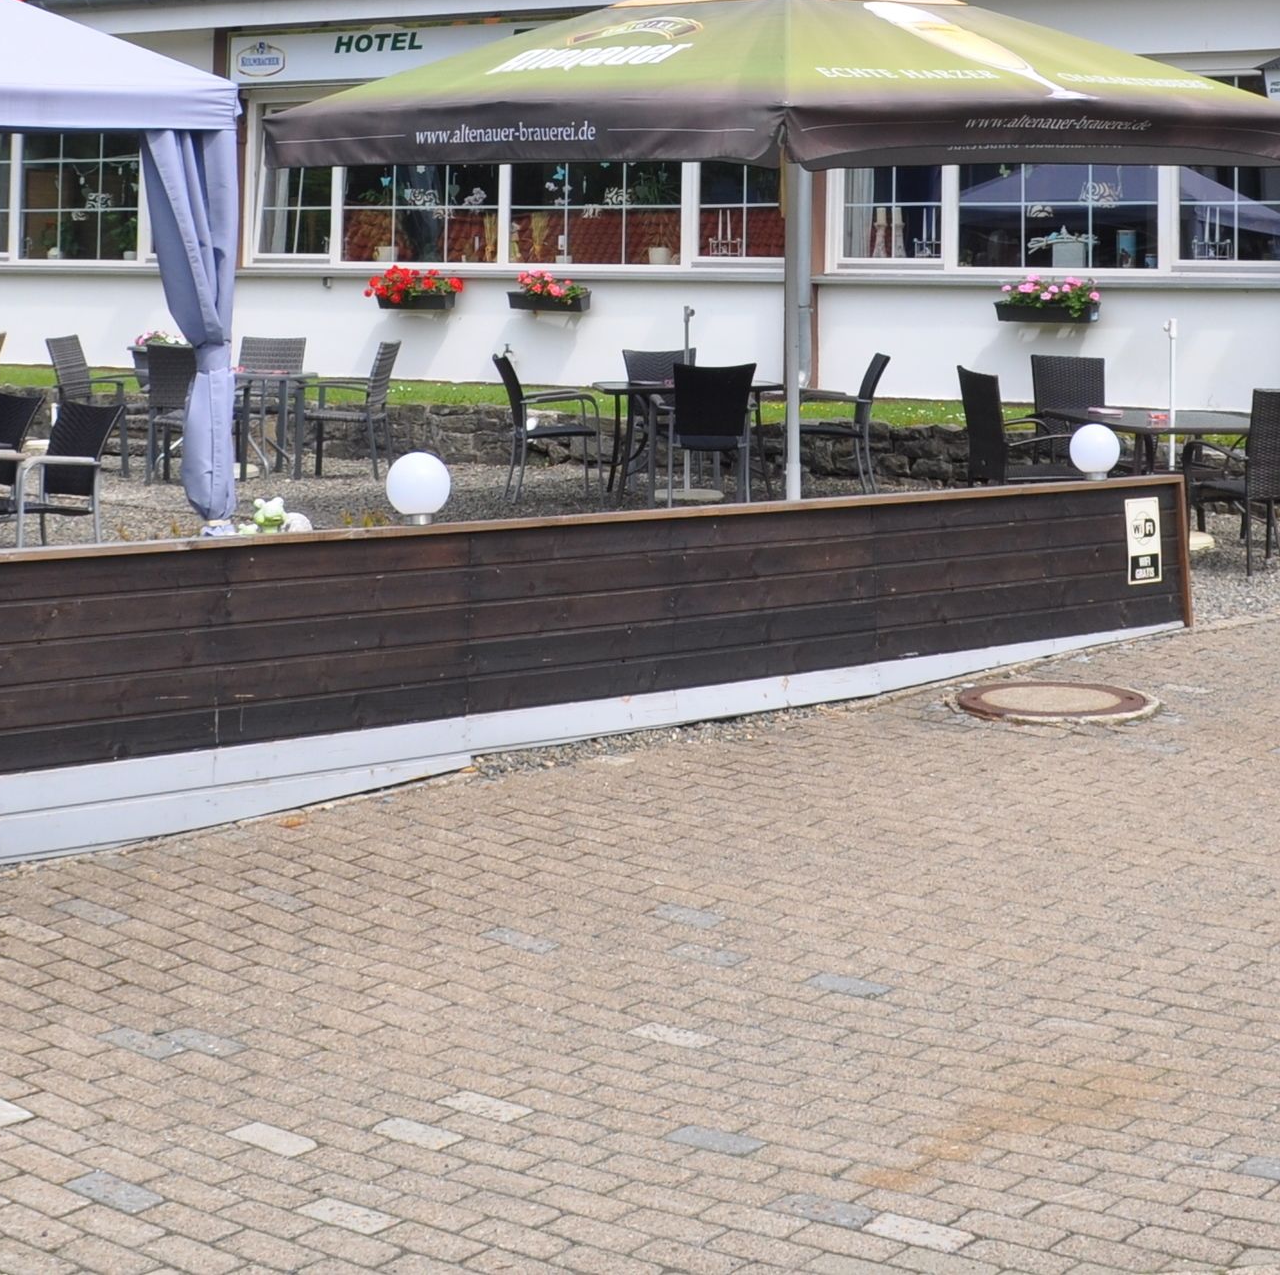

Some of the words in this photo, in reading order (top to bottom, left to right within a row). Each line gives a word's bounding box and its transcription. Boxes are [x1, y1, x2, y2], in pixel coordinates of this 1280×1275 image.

[334, 31, 423, 54] HOTEL
[815, 66, 899, 78] ECHTE
[899, 68, 1001, 79] HARZER
[415, 120, 596, 145] www.altenauer-brauerei.de
[965, 114, 1152, 131] www.altenauer-brauerei.de
